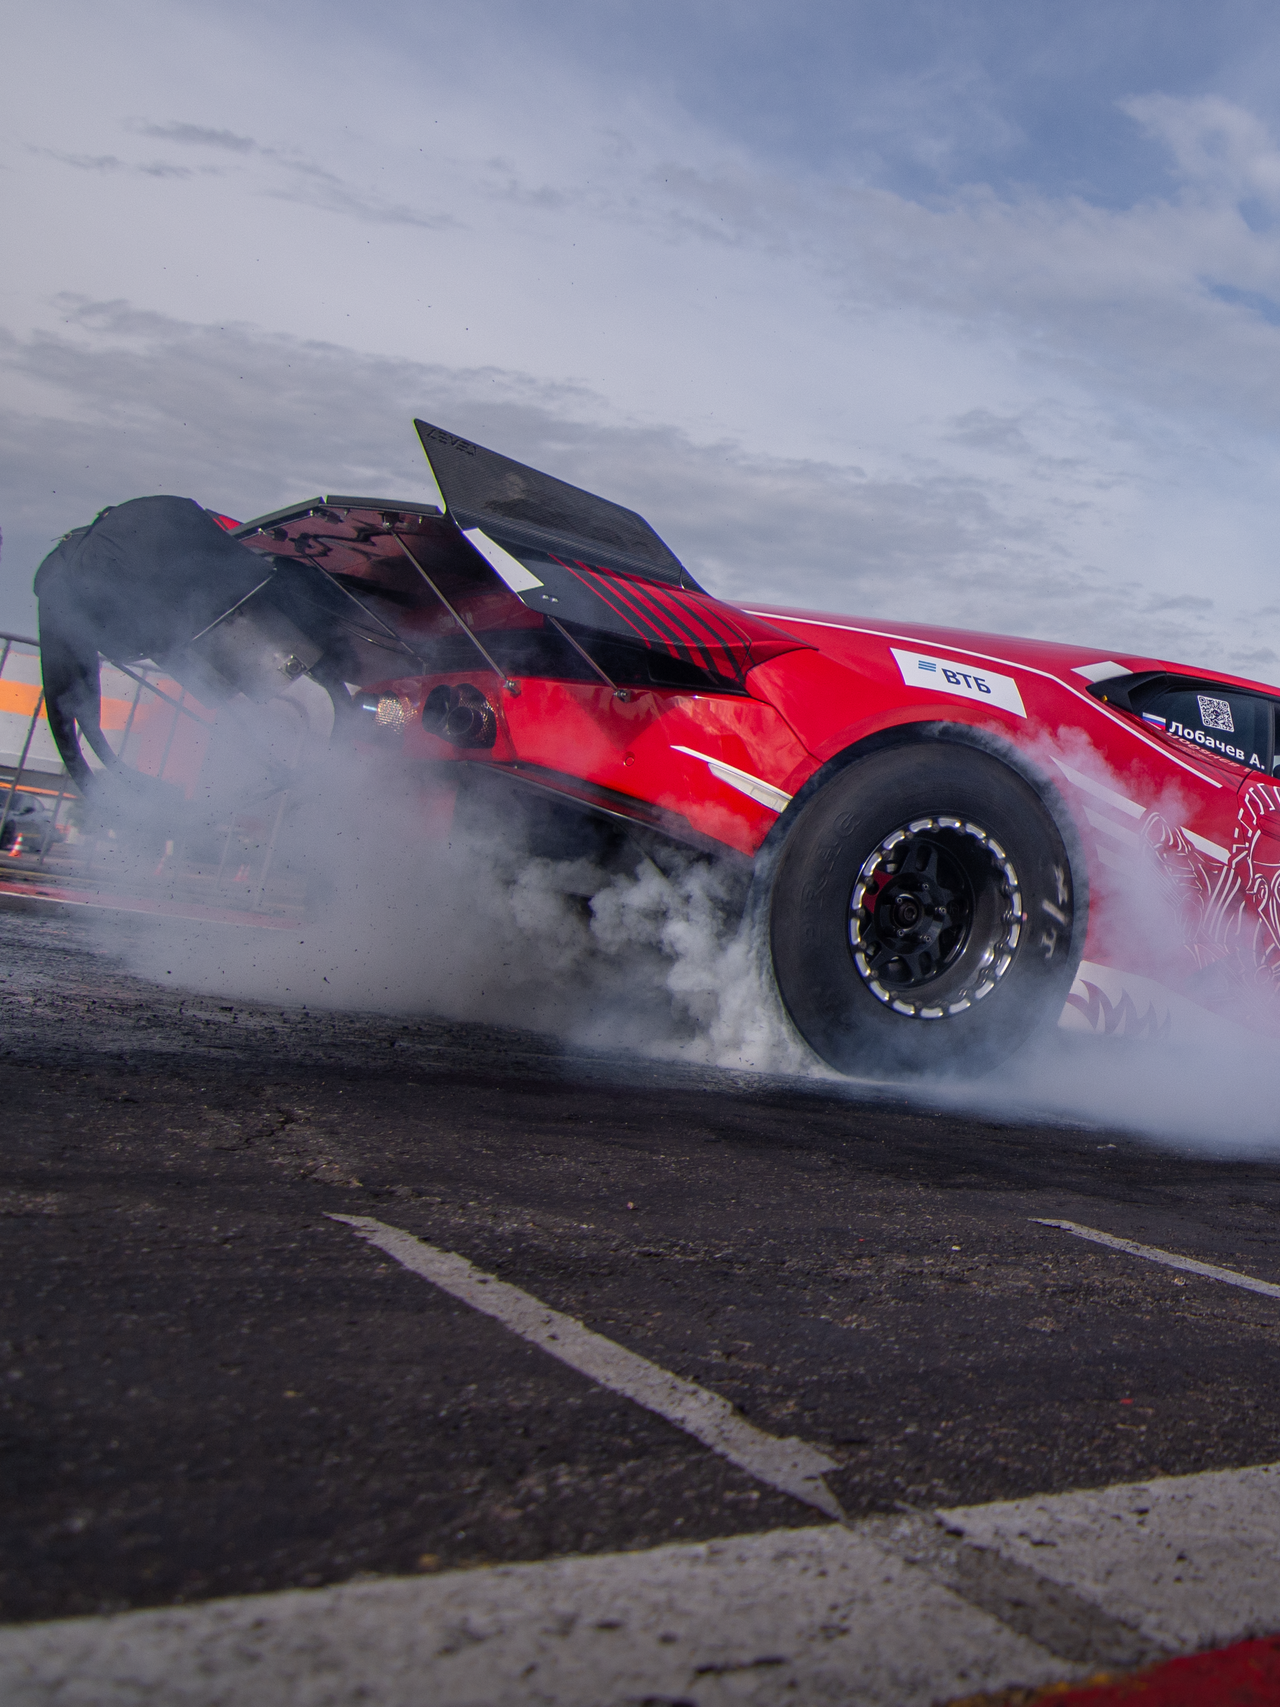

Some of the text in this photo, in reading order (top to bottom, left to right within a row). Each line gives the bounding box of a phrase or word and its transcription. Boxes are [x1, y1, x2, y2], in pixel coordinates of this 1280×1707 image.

[941, 667, 992, 694] ВТБ
[1168, 721, 1265, 770] Лобачев А.
